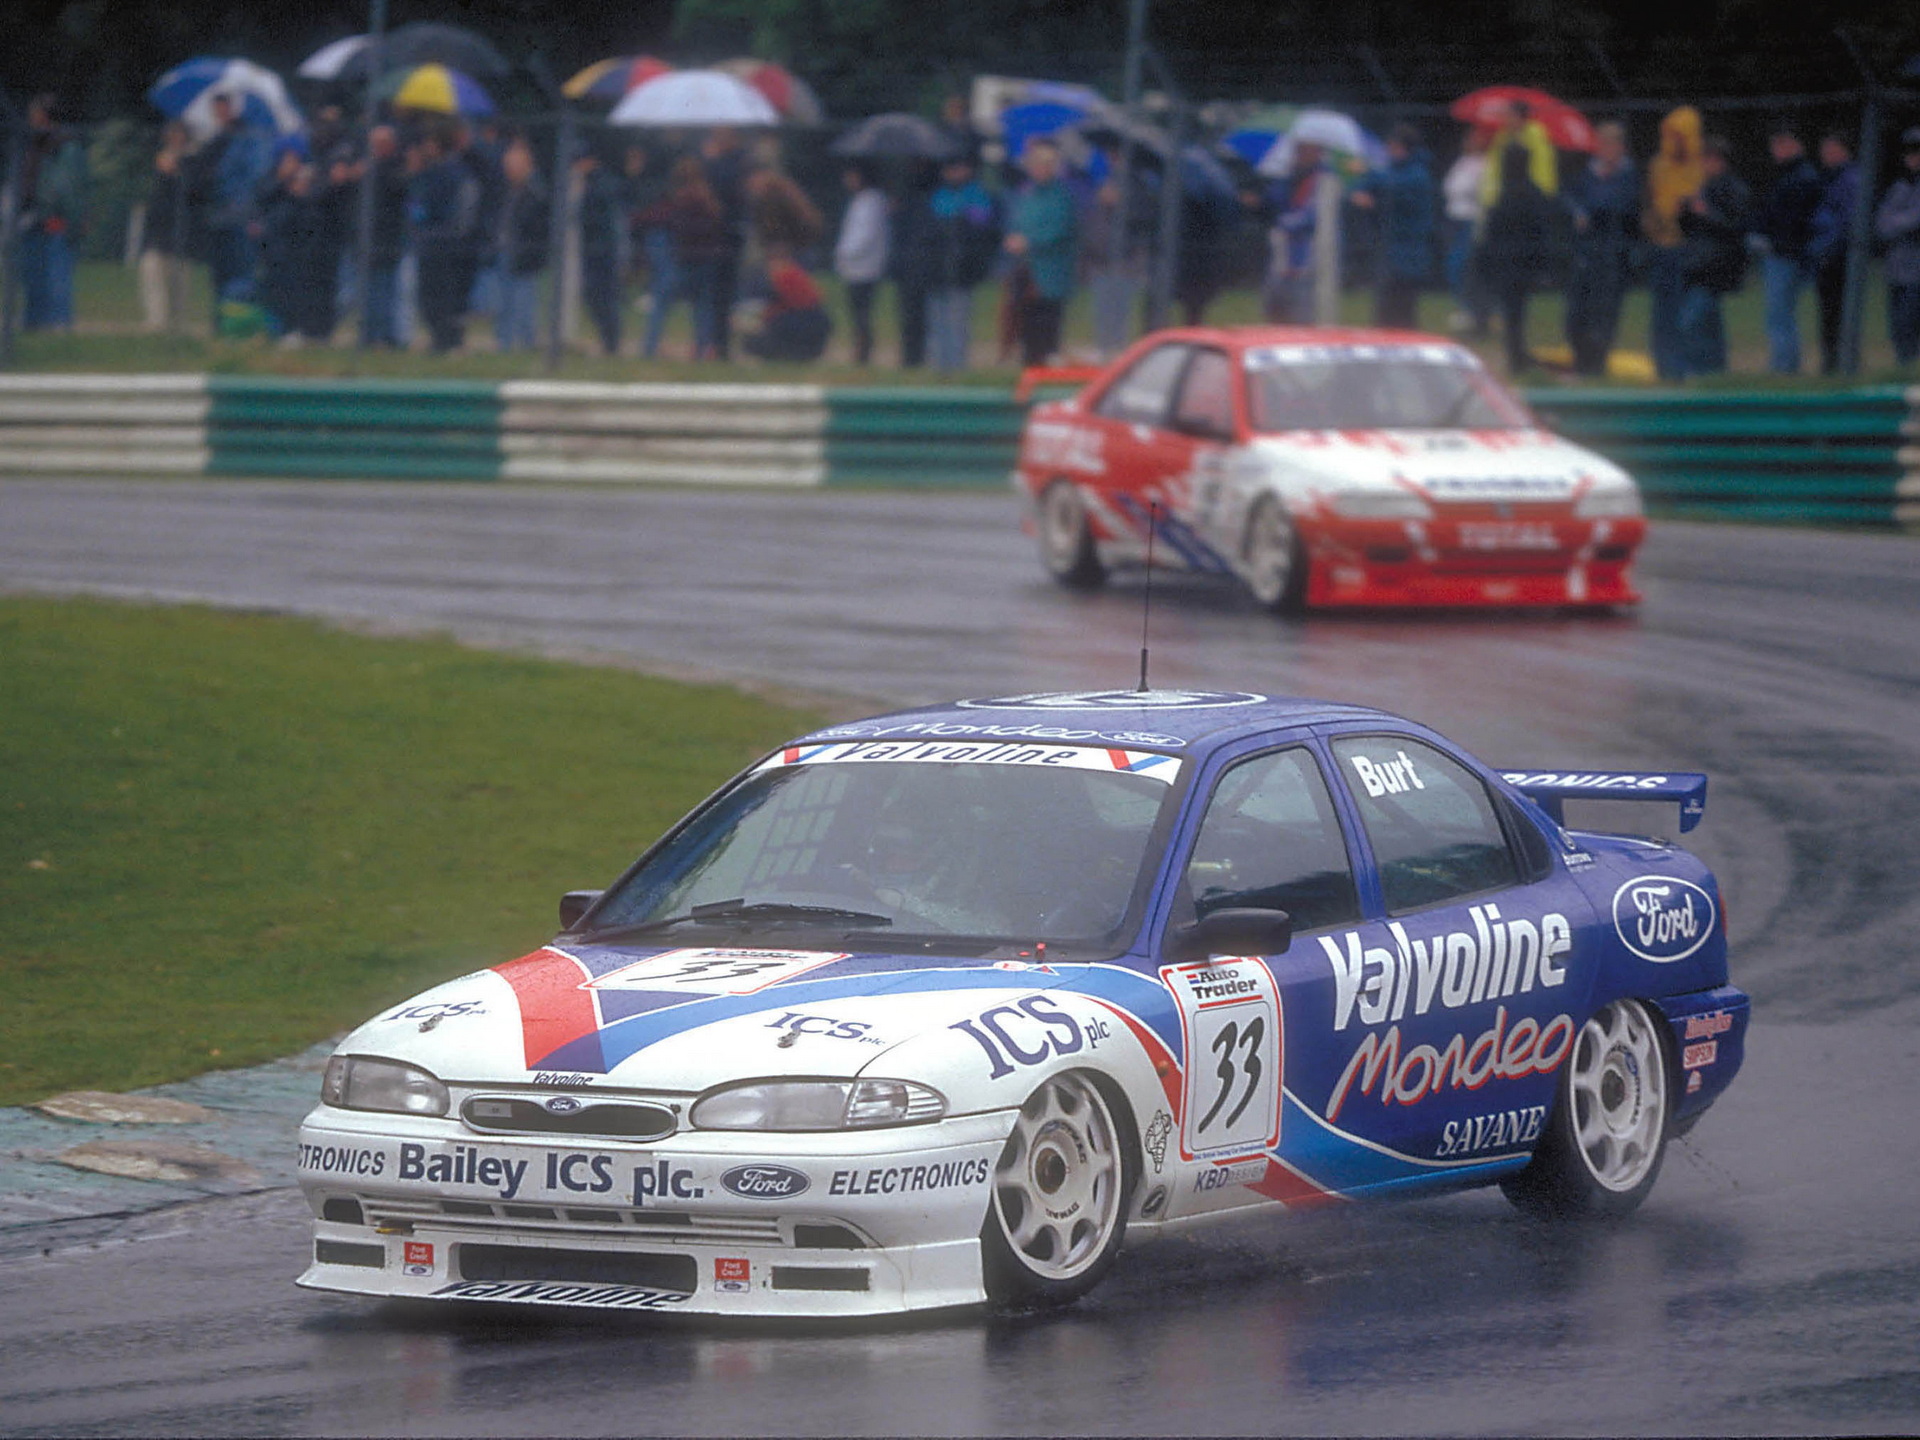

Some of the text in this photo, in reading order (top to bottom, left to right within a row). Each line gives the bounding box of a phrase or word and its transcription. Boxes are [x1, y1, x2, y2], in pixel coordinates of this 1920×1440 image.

[872, 722, 1099, 740] Mondeo
[832, 742, 1079, 764] Valvoline
[1351, 750, 1425, 798] Burt
[1632, 886, 1698, 946] Ford
[625, 960, 787, 983] 33
[1198, 969, 1239, 983] Auto
[1317, 903, 1572, 1031] Valvoline
[1191, 979, 1257, 999] Trader
[381, 1001, 483, 1022] ICS
[764, 1012, 886, 1046] ICS plc
[947, 995, 1110, 1080] ICS plc
[532, 1072, 594, 1086] Valvoline
[1198, 1016, 1265, 1134] 33
[1326, 1005, 1575, 1123] Mondeo
[1436, 1106, 1545, 1157] SAVANE
[399, 1142, 528, 1199] Bailey
[547, 1152, 613, 1193] ICS
[633, 1160, 704, 1206] plc.
[737, 1169, 792, 1193] Ford
[829, 1158, 989, 1195] ELECTRONICS
